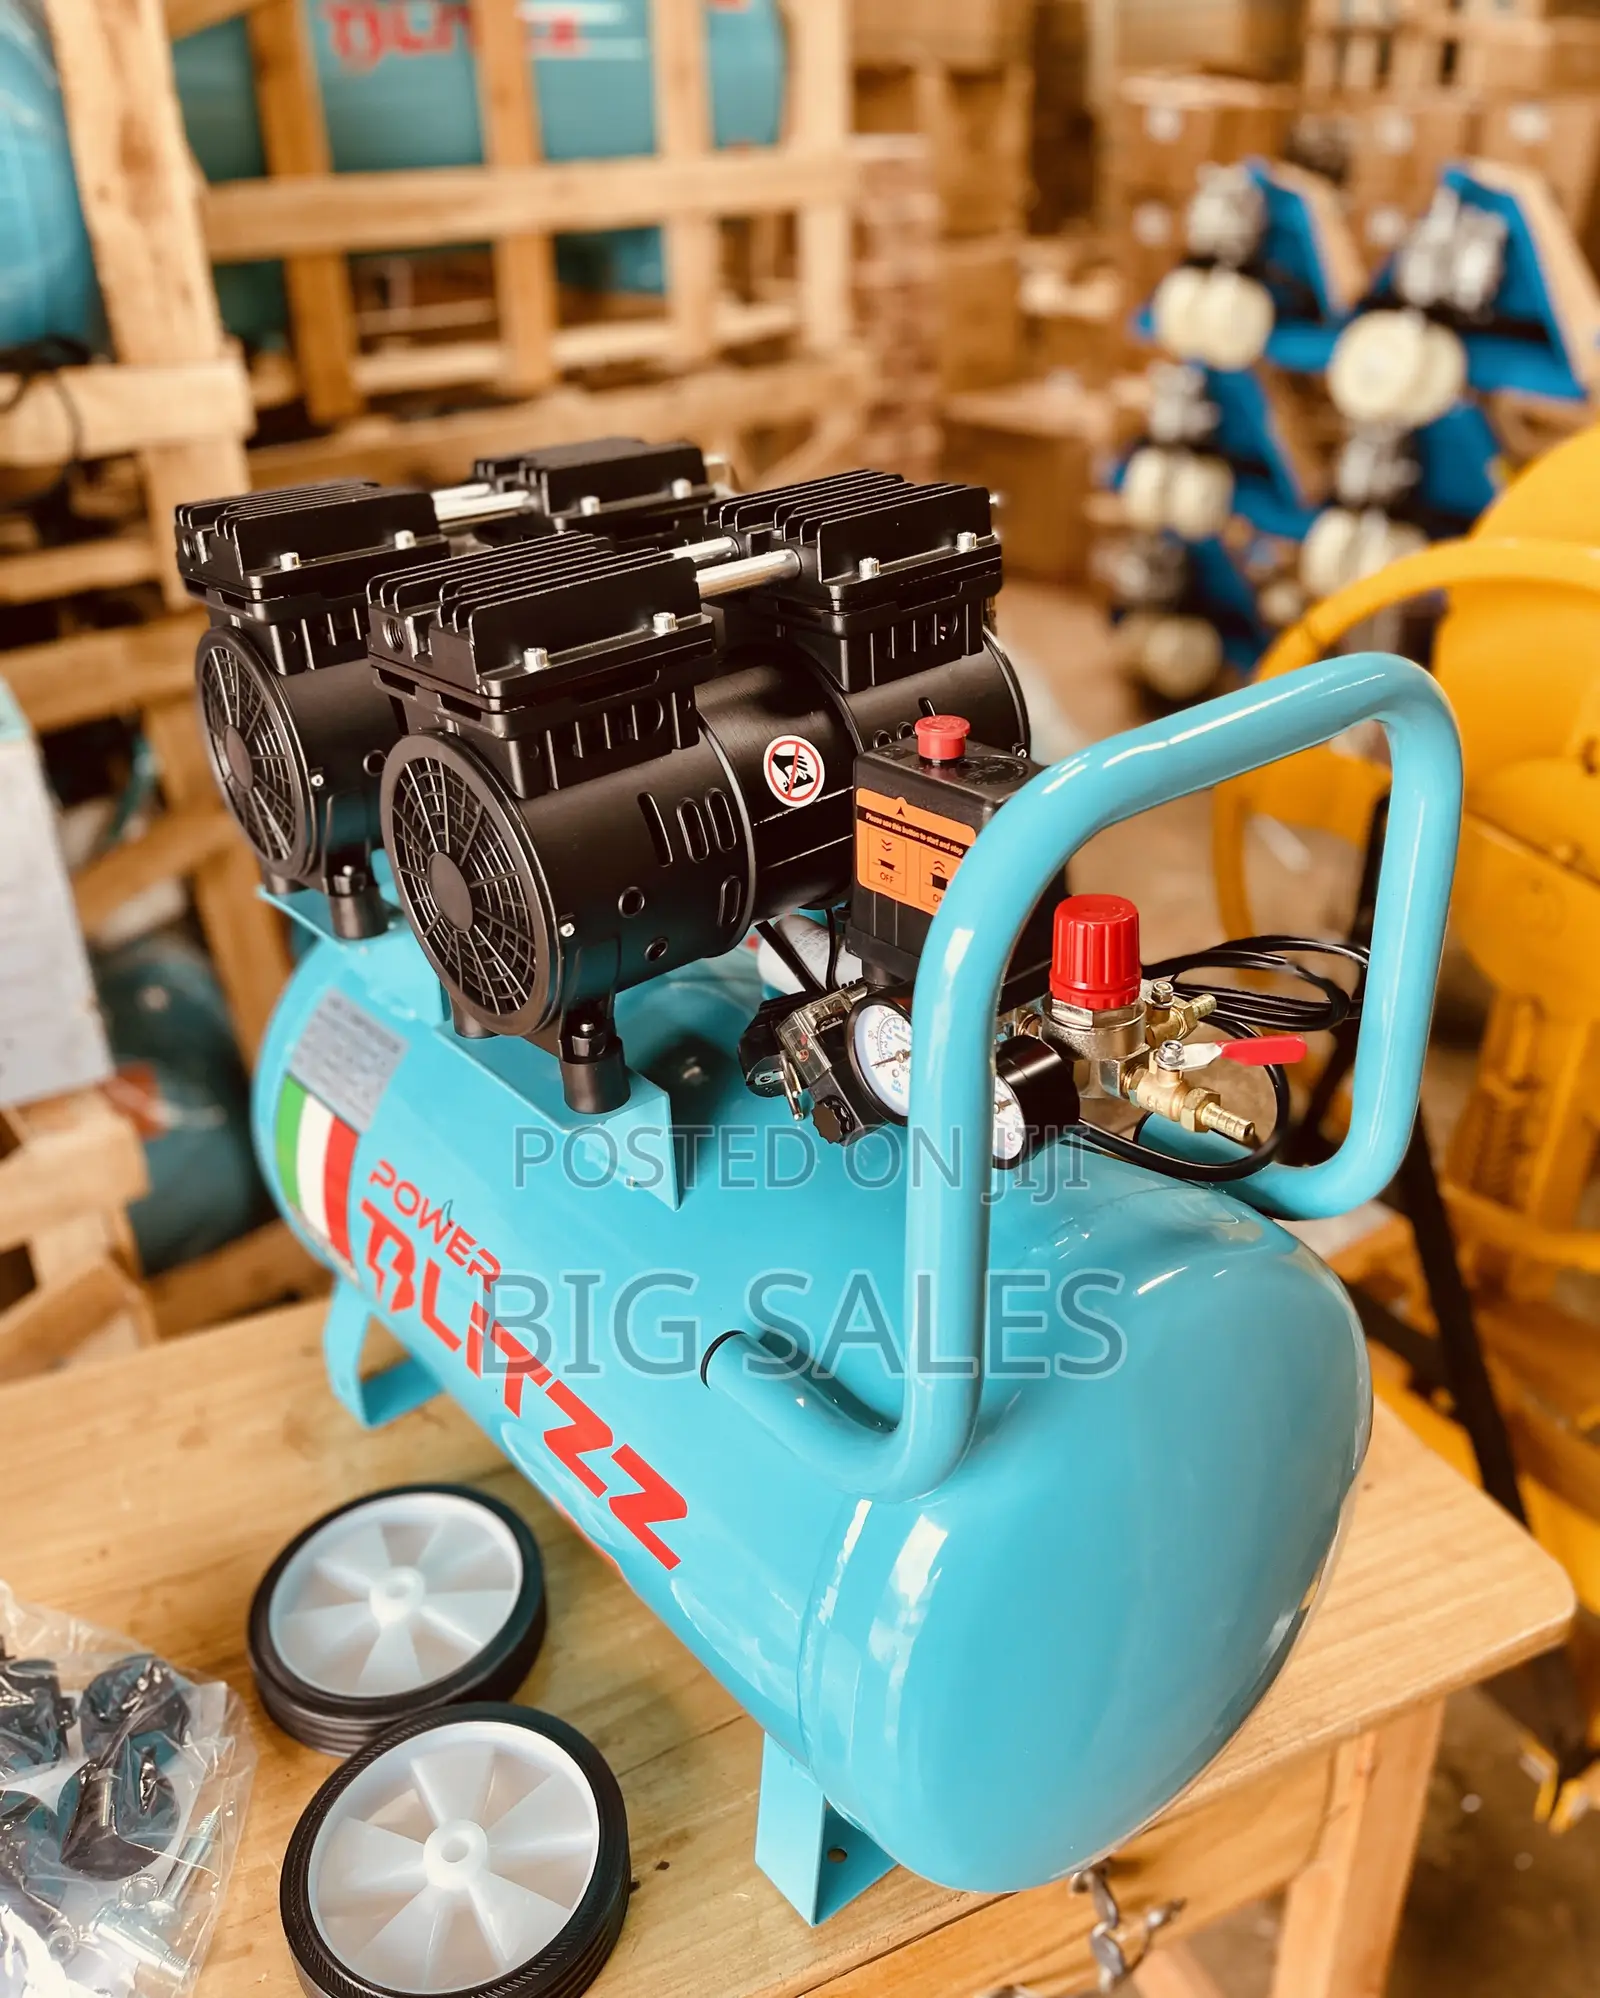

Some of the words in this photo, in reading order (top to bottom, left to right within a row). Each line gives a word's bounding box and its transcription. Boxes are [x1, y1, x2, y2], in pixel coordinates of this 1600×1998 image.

[865, 812, 882, 825] Please
[883, 819, 892, 828] use
[892, 821, 901, 832] this
[902, 826, 919, 839] button
[920, 832, 926, 841] to
[927, 836, 939, 846] start
[939, 840, 950, 850] and
[950, 845, 963, 856] stop
[880, 871, 894, 883] OFF
[933, 893, 942, 903] O
[368, 1159, 502, 1294] POWER
[360, 1197, 688, 1571] BLITZZ
